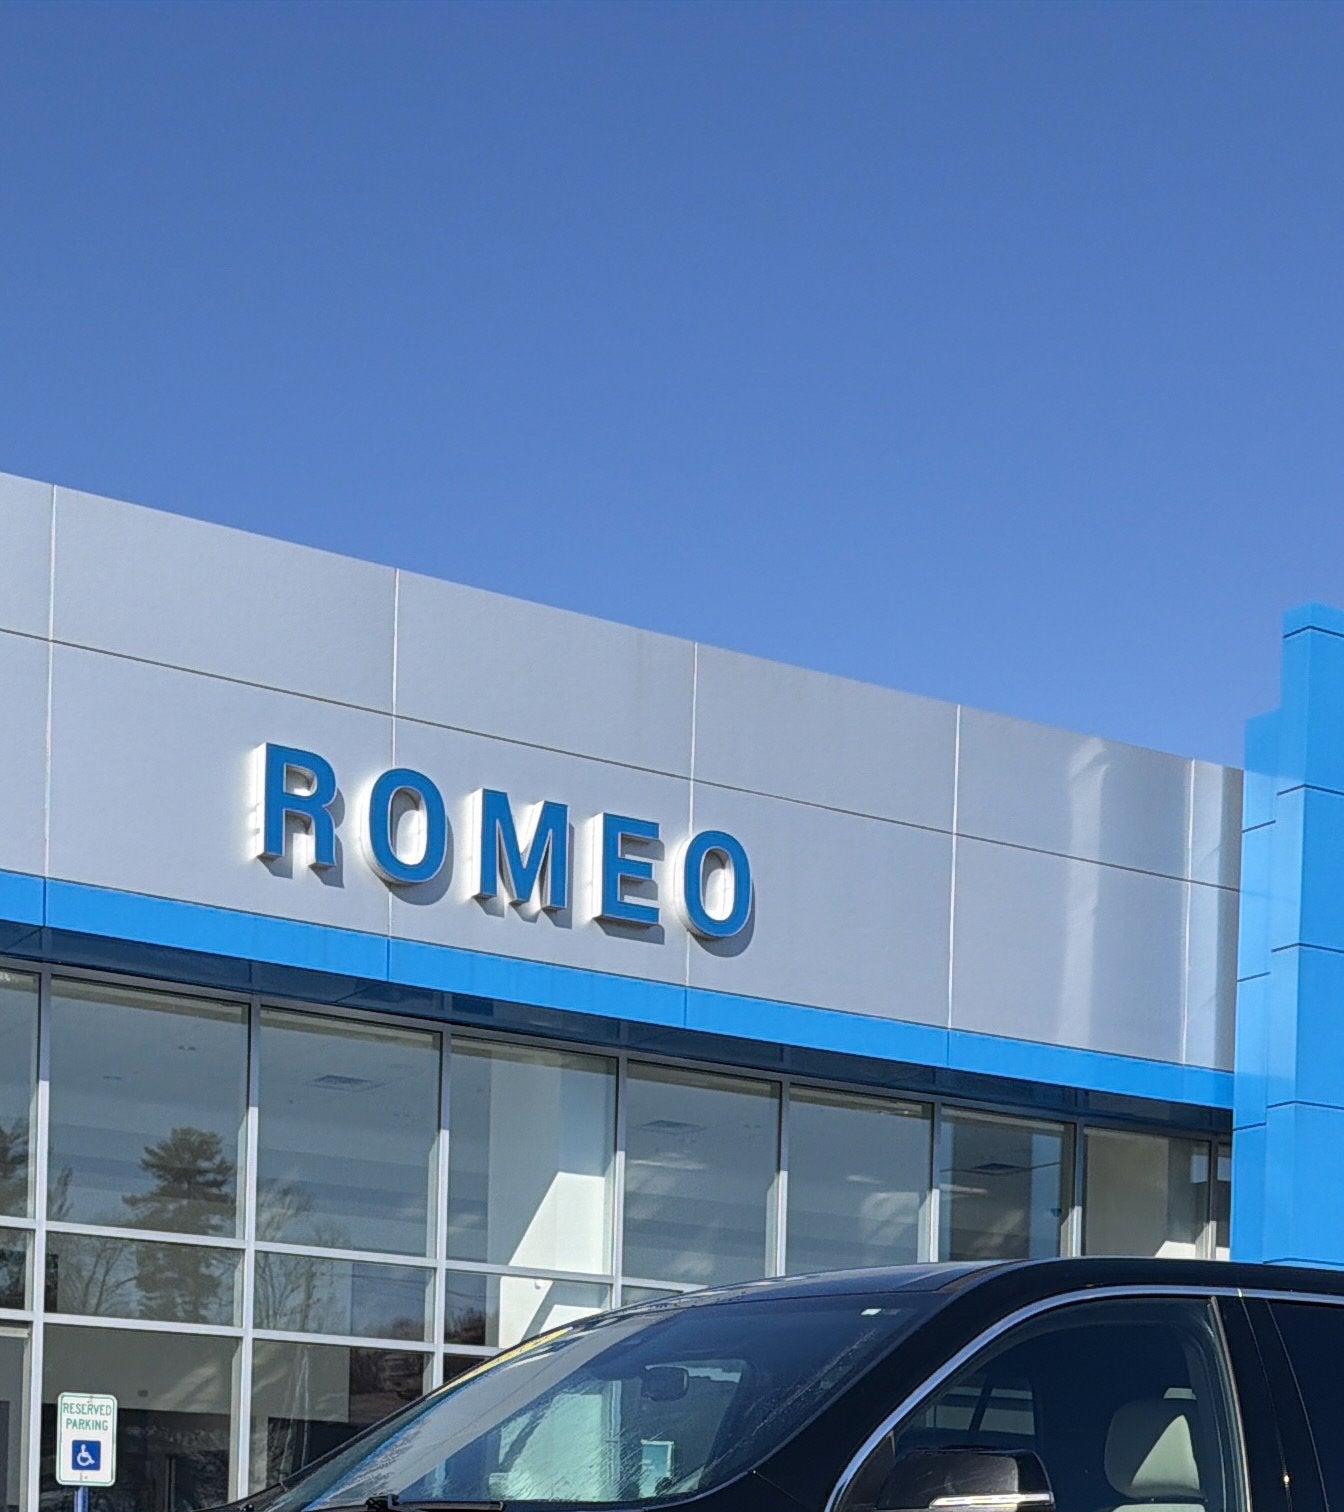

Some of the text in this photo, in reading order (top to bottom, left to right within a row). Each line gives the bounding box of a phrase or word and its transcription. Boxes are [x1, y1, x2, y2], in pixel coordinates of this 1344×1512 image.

[257, 742, 753, 938] ROMEO
[62, 1402, 112, 1416] RESERVED
[65, 1418, 109, 1431] PARKING
